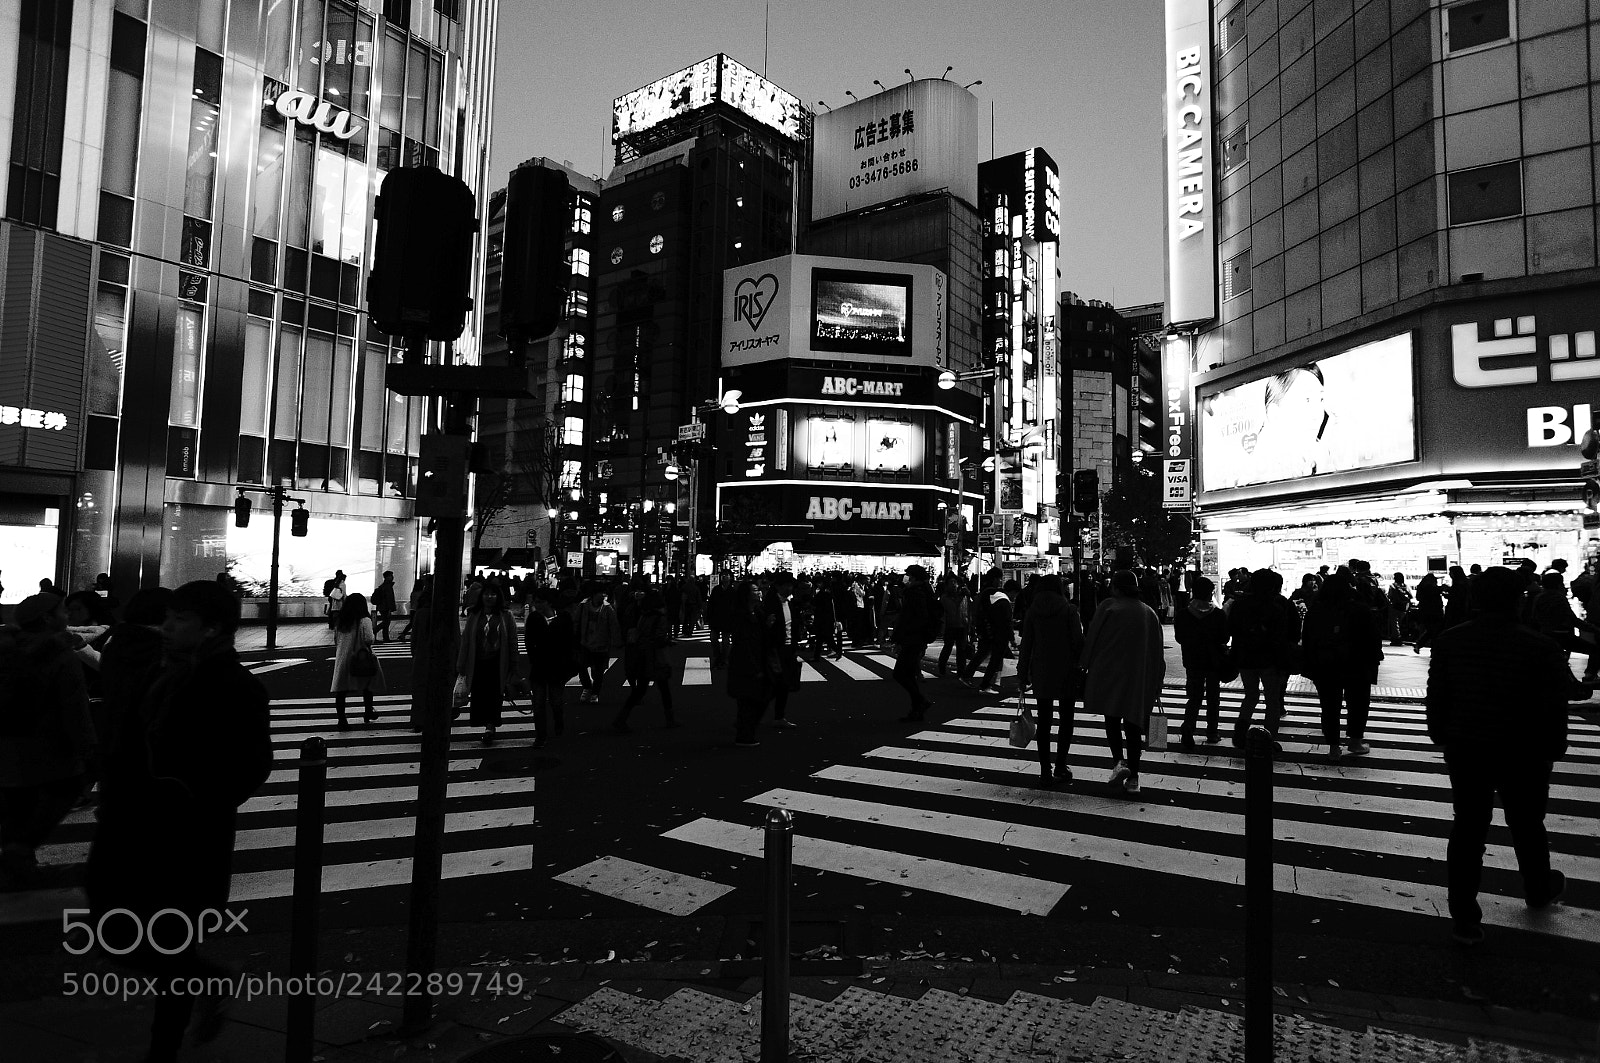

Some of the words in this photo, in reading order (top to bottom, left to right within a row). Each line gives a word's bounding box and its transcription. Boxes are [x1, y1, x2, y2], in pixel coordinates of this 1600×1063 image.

[1176, 46, 1202, 101] BIC
[275, 90, 363, 139] au
[854, 109, 914, 151] 広告主募集
[860, 148, 906, 169] お問い合わせ
[1177, 104, 1204, 241] CAMERA
[849, 159, 918, 189] 03-3476-5686
[734, 291, 763, 322] IRIS
[729, 334, 780, 352] アイリスオーヤマ
[821, 376, 903, 396] ABC-MART
[1168, 475, 1188, 484] VISA
[806, 496, 913, 520] ABC-MART
